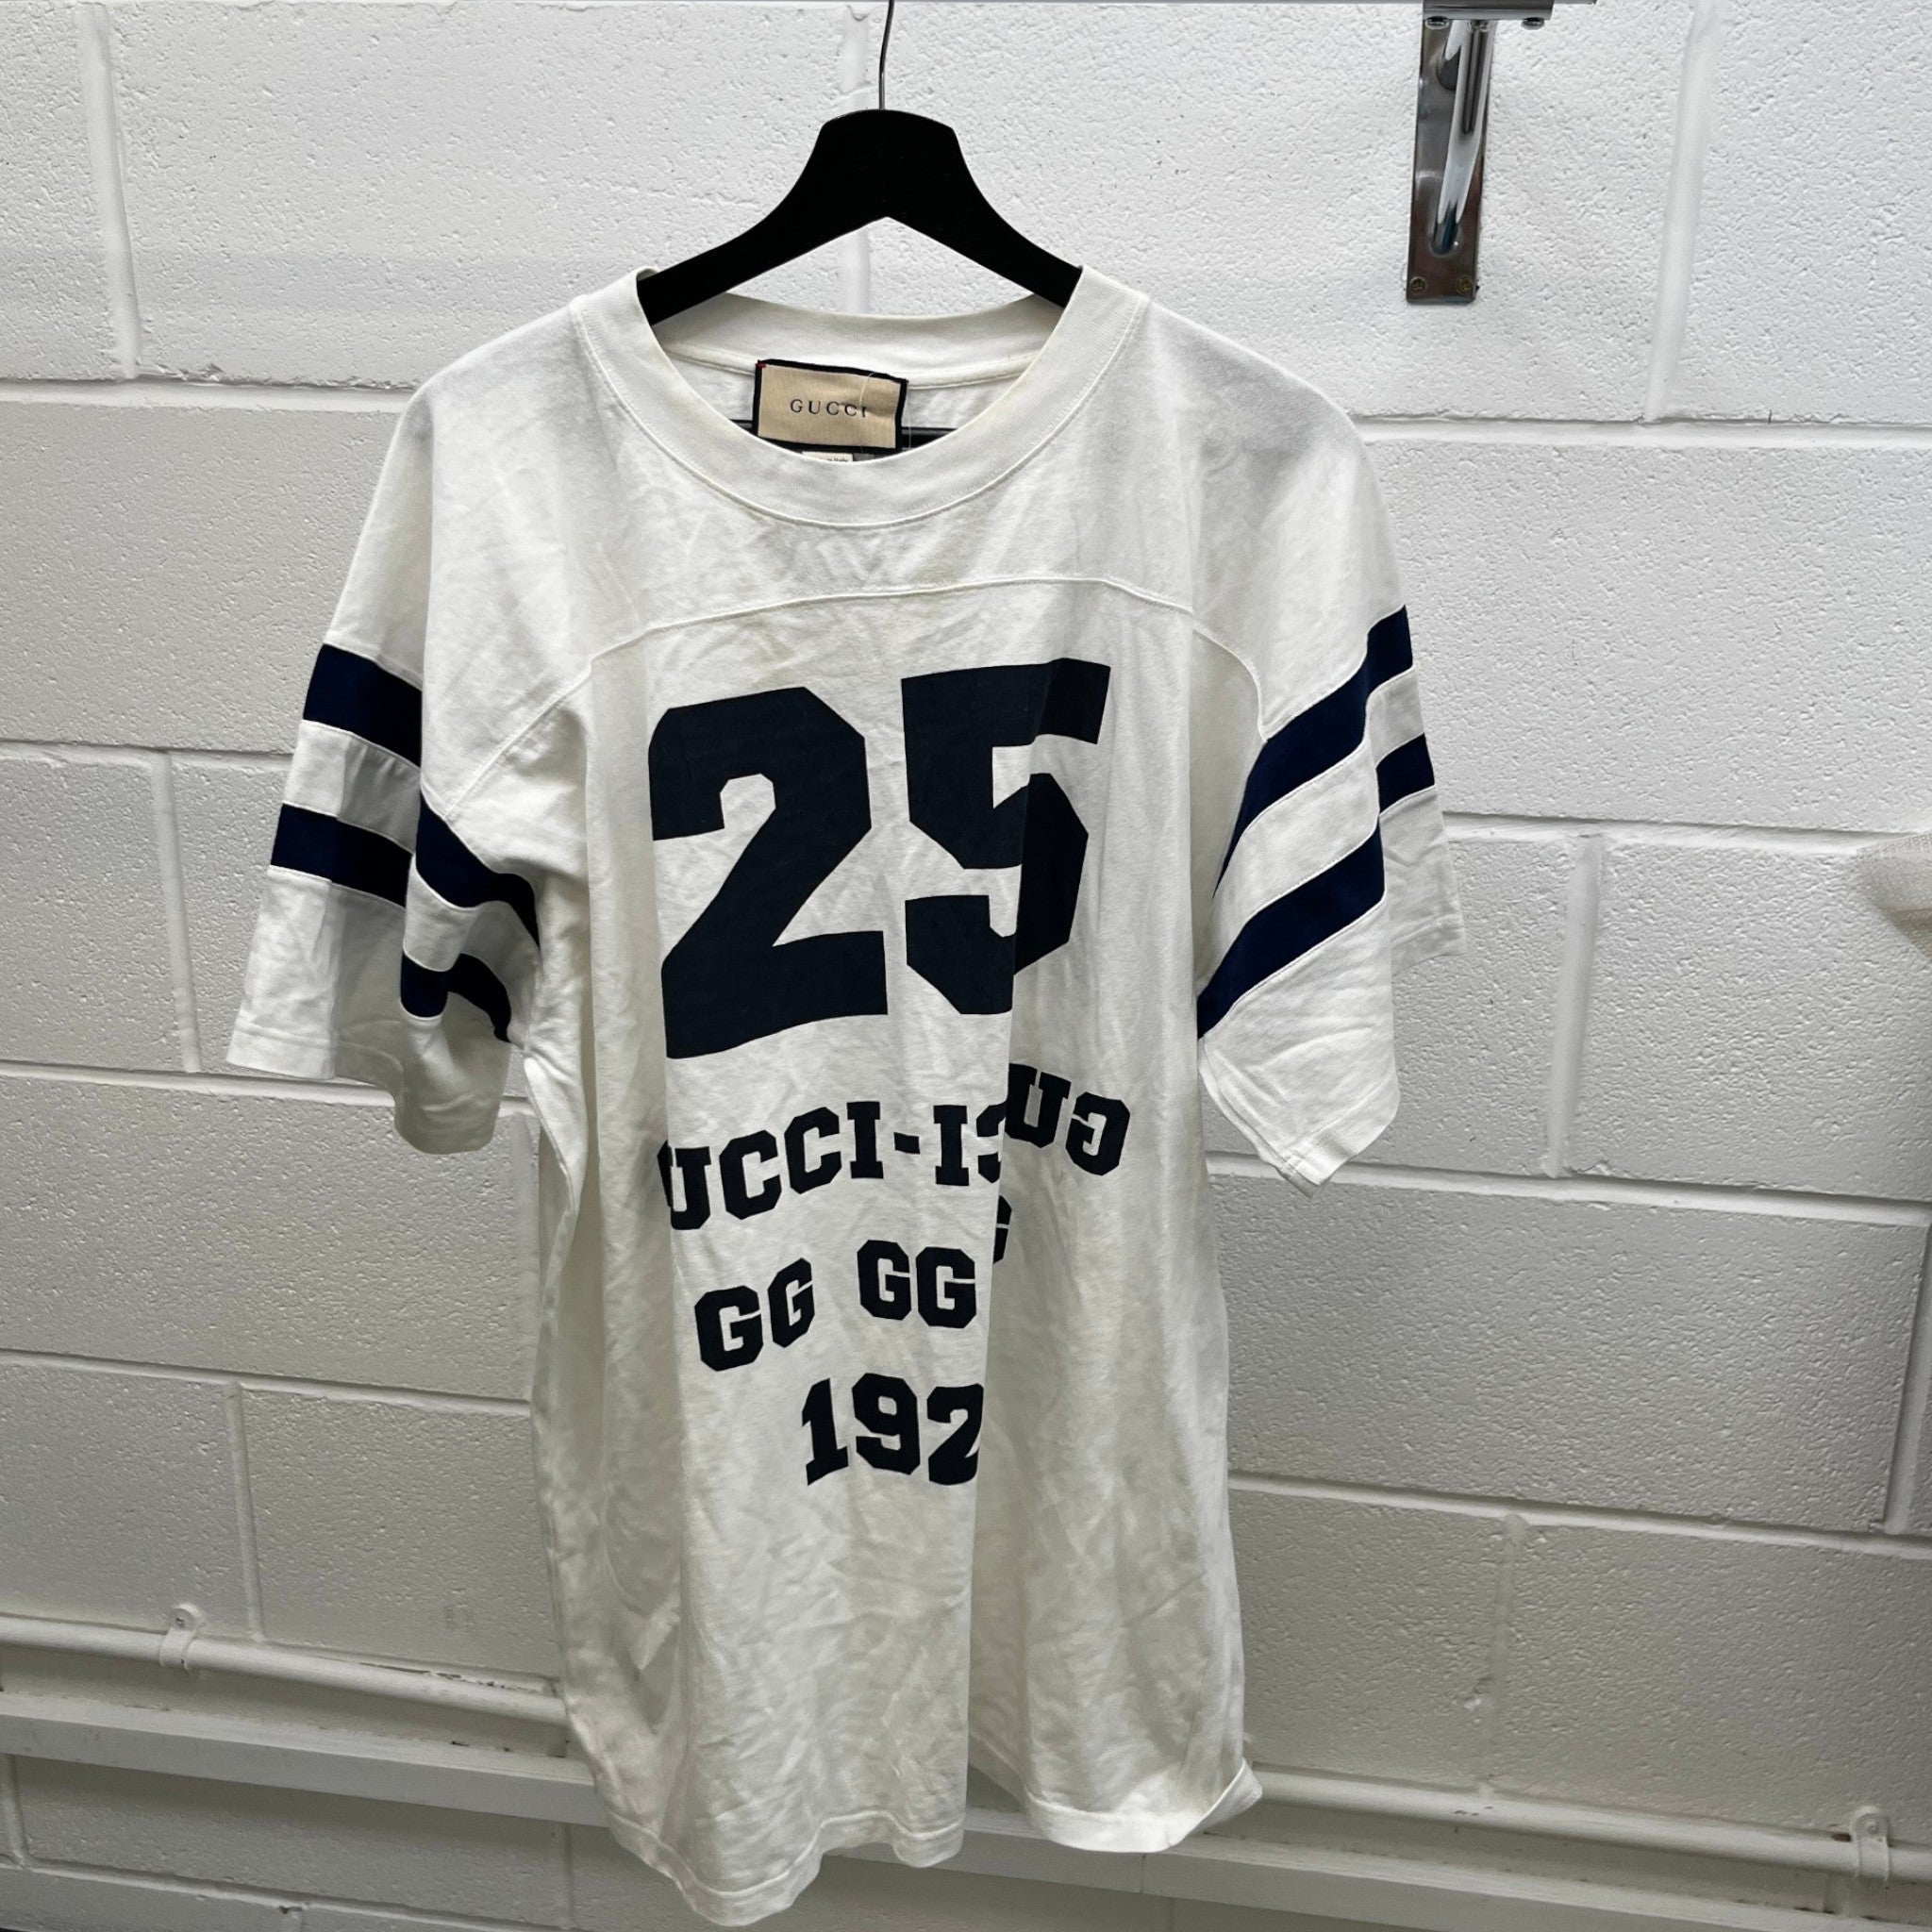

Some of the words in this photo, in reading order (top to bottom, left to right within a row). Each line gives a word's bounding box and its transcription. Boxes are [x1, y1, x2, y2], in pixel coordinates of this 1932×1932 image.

[790, 398, 867, 418] GUCCI
[648, 657, 1111, 1059] 25
[693, 1257, 816, 1373] GG
[857, 1239, 977, 1329] GG
[801, 1372, 985, 1487] 192
